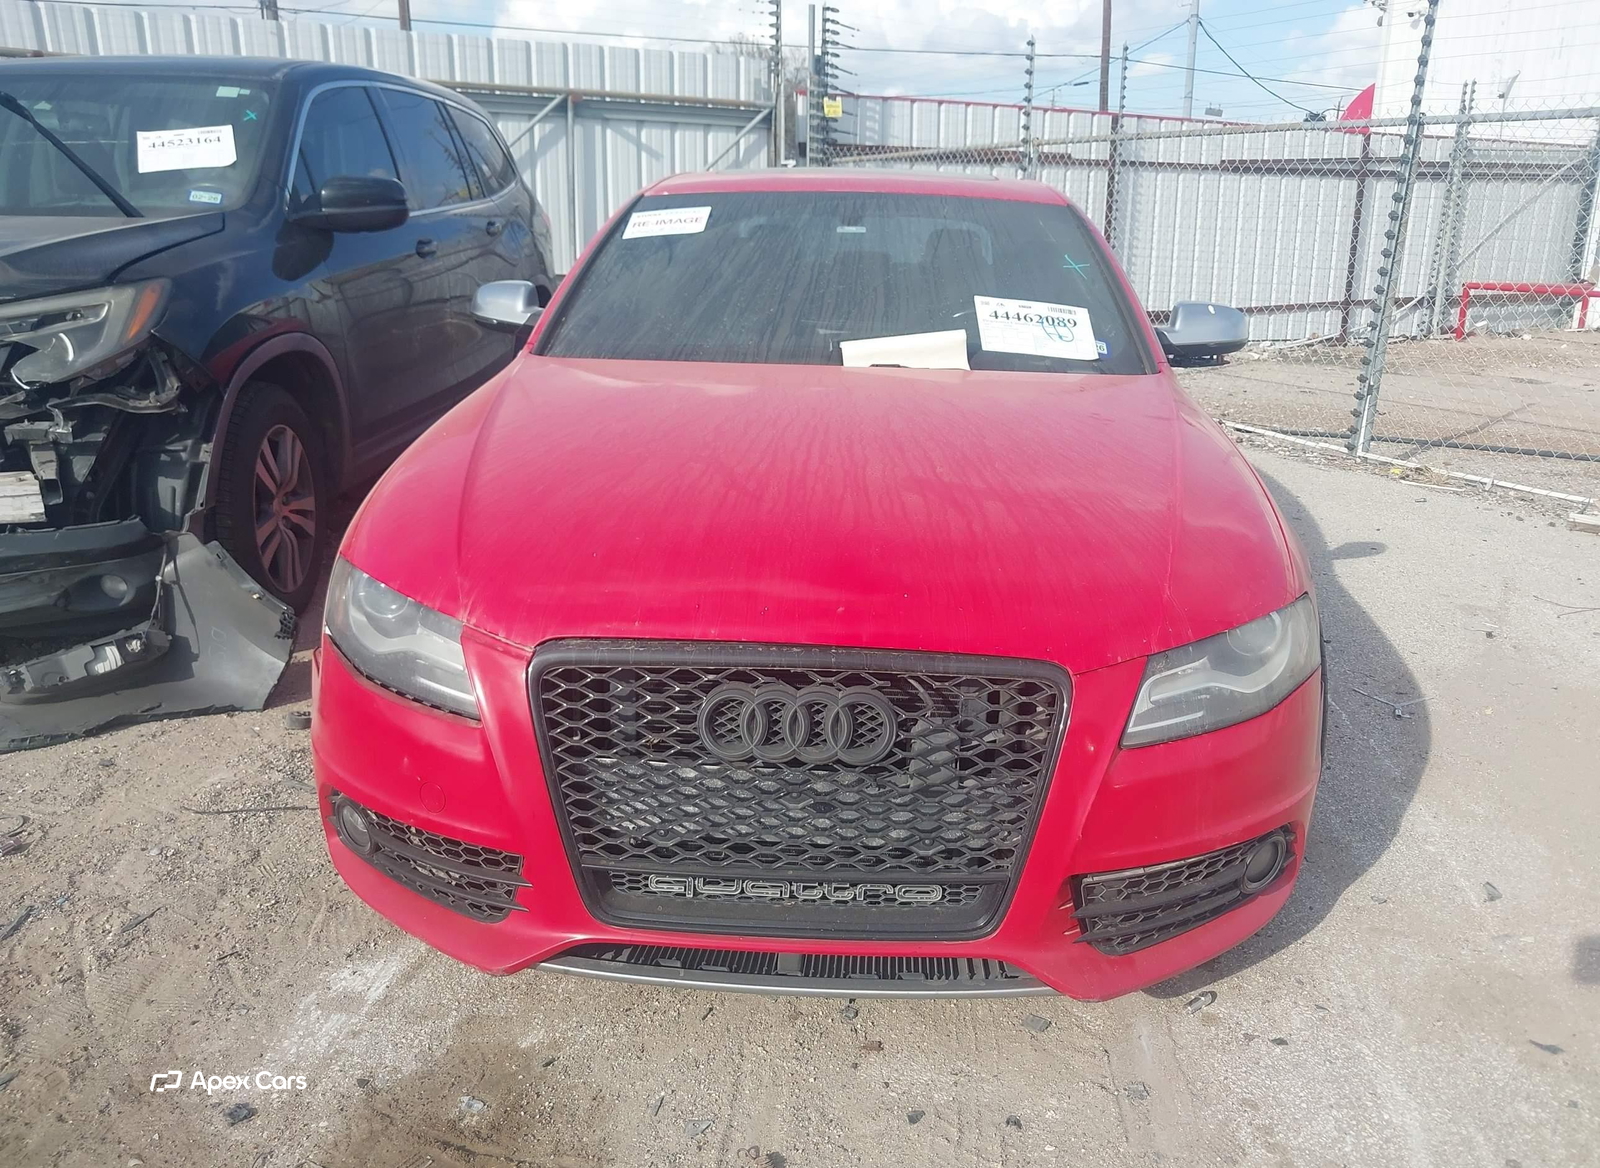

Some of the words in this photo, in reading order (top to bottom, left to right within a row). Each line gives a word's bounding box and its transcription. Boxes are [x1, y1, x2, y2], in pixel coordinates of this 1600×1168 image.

[148, 136, 222, 149] 44523164
[989, 310, 1077, 328] 44462089
[649, 873, 943, 901] quattro
